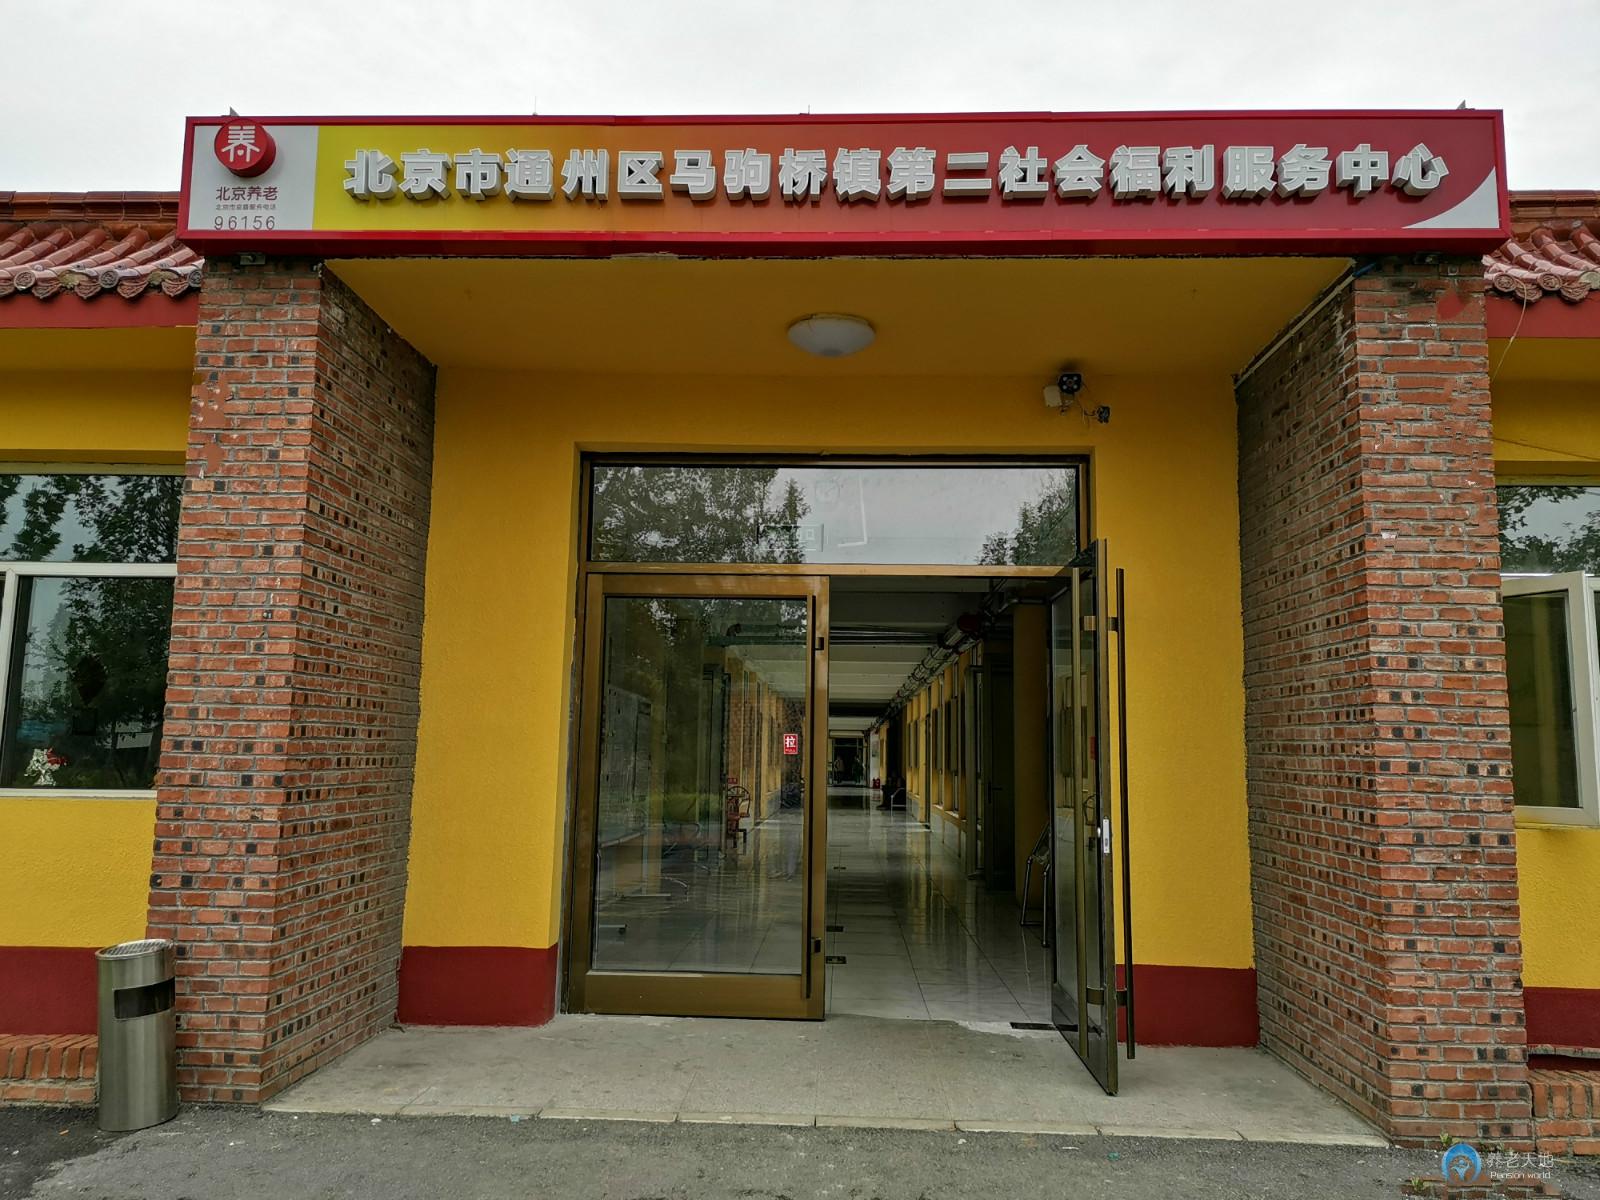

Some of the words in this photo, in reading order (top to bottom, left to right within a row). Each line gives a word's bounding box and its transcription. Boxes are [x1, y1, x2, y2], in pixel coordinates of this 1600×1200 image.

[343, 143, 1450, 200] 北京市通州区马驹桥镇第二社会福利服务中心
[215, 186, 278, 201] 北京养老
[214, 215, 275, 230] 96156
[785, 735, 796, 748] 拉
